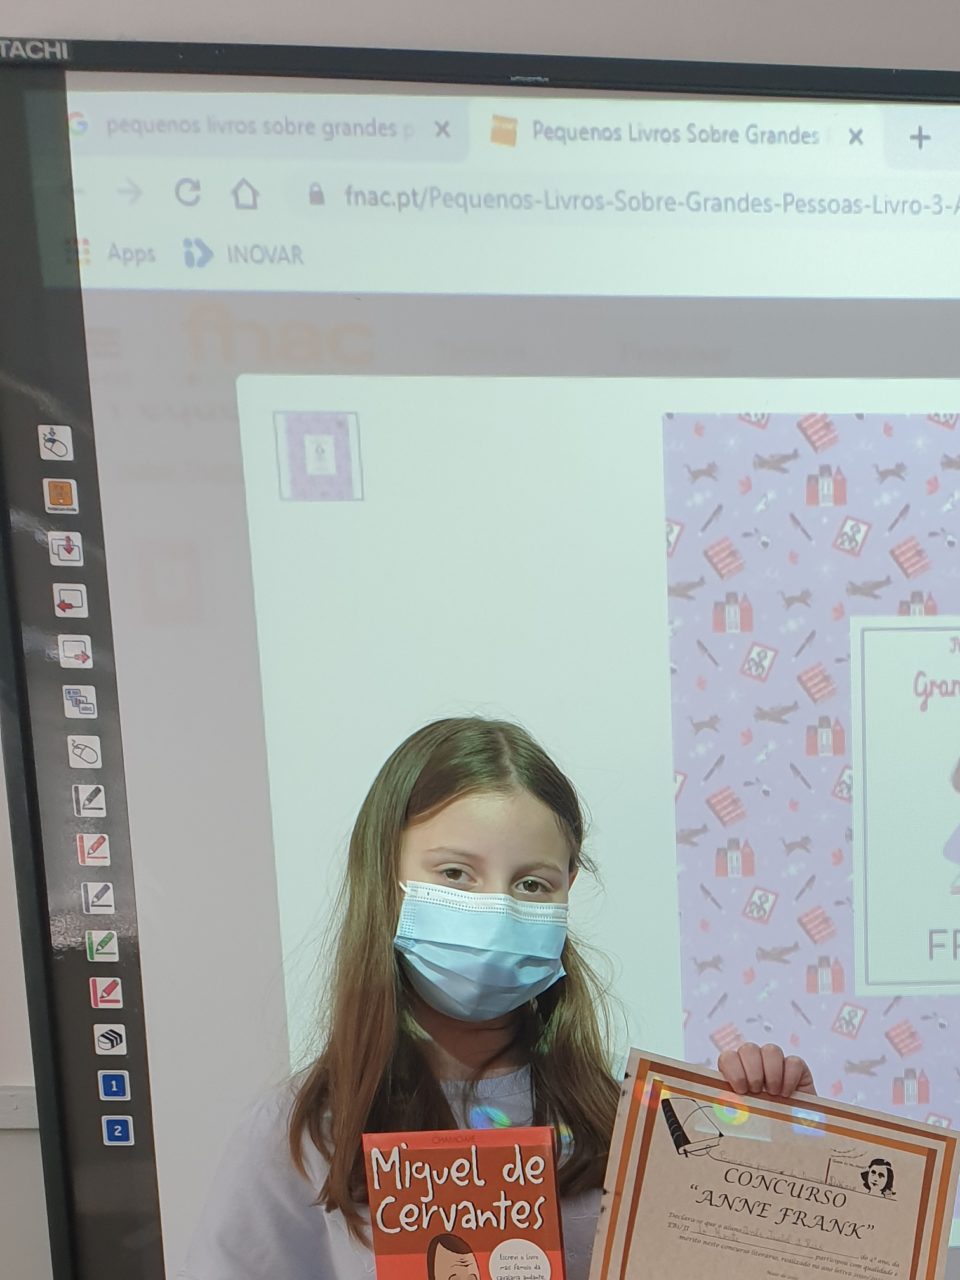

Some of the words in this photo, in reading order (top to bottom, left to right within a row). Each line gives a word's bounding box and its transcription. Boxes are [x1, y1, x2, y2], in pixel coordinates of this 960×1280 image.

[106, 116, 201, 138] pequenos
[206, 114, 257, 136] livros
[263, 115, 316, 137] sobre
[322, 118, 398, 141] grandes
[532, 120, 622, 145] Pequenos
[628, 121, 681, 143] Livros
[686, 122, 740, 144] Sobre
[746, 124, 820, 145] Grandes
[107, 243, 157, 266] Apps
[227, 244, 304, 266] INOVAR
[111, 1079, 118, 1092] 1
[113, 1125, 123, 1137] 2
[370, 1142, 486, 1202] Miguel
[502, 1143, 546, 1187] de
[722, 1167, 848, 1208] CONCURSO
[376, 1190, 547, 1235] Cervantes
